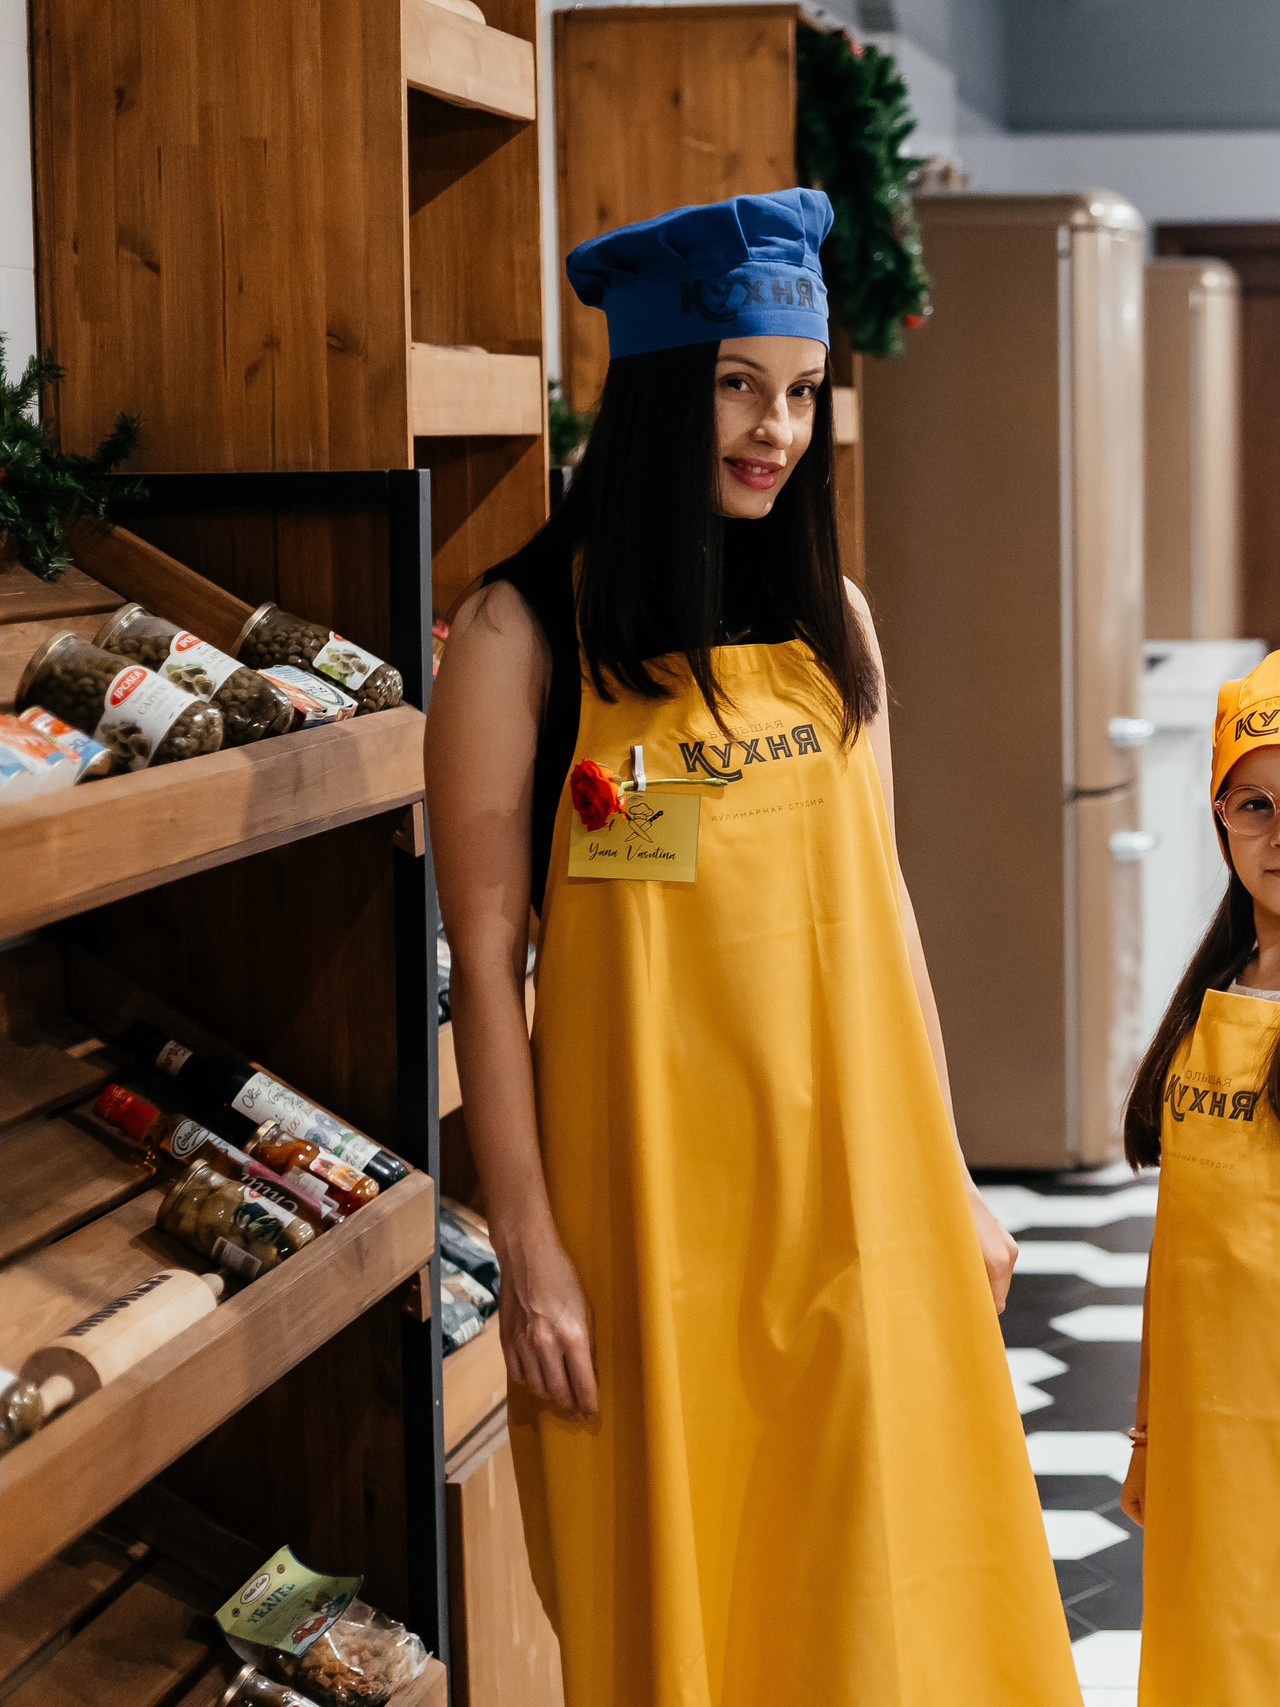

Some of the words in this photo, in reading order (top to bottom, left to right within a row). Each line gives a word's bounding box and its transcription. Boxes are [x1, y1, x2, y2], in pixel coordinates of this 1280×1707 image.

[680, 277, 815, 323] КУХНЯ
[112, 670, 144, 699] IPOSEA
[678, 723, 822, 783] КУХНЯ
[711, 805, 784, 823] КУЛИНАРНАЯ
[788, 797, 825, 811] СТУДИЯ
[588, 842, 619, 861] Yana
[1185, 1069, 1232, 1088] ОЛЬШАЯ
[242, 1087, 262, 1109] Olio
[1165, 1074, 1256, 1122] КУХНЯ
[247, 1583, 296, 1623] TRAVEL
